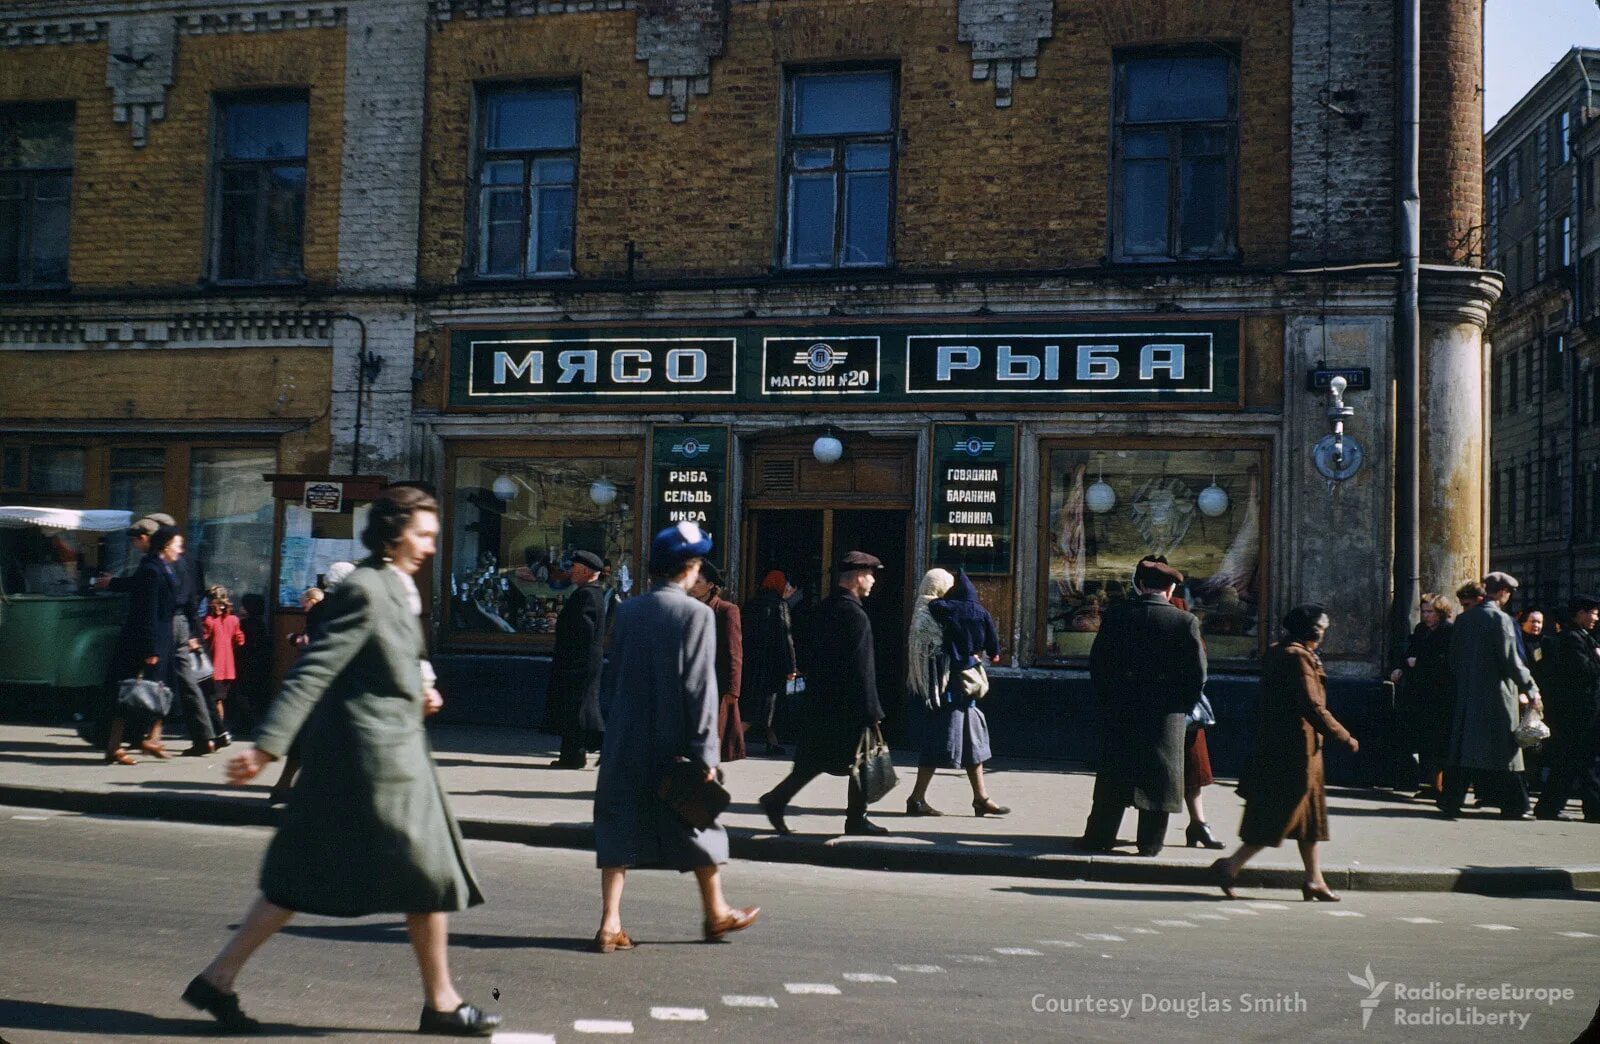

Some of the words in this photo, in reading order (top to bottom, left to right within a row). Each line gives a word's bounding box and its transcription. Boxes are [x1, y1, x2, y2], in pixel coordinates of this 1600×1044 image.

[492, 349, 708, 385] МЯСО
[936, 343, 1187, 381] РЫБА
[770, 375, 835, 388] МАГАЗИН
[669, 471, 708, 483] РЫБА
[947, 469, 998, 481] ГОВЯДИНА
[664, 490, 712, 503] СЕЛЬДЬ
[946, 490, 996, 503] БАРАНИНА
[948, 511, 993, 524] СВИНИНА
[948, 534, 994, 547] ПТИЦА
